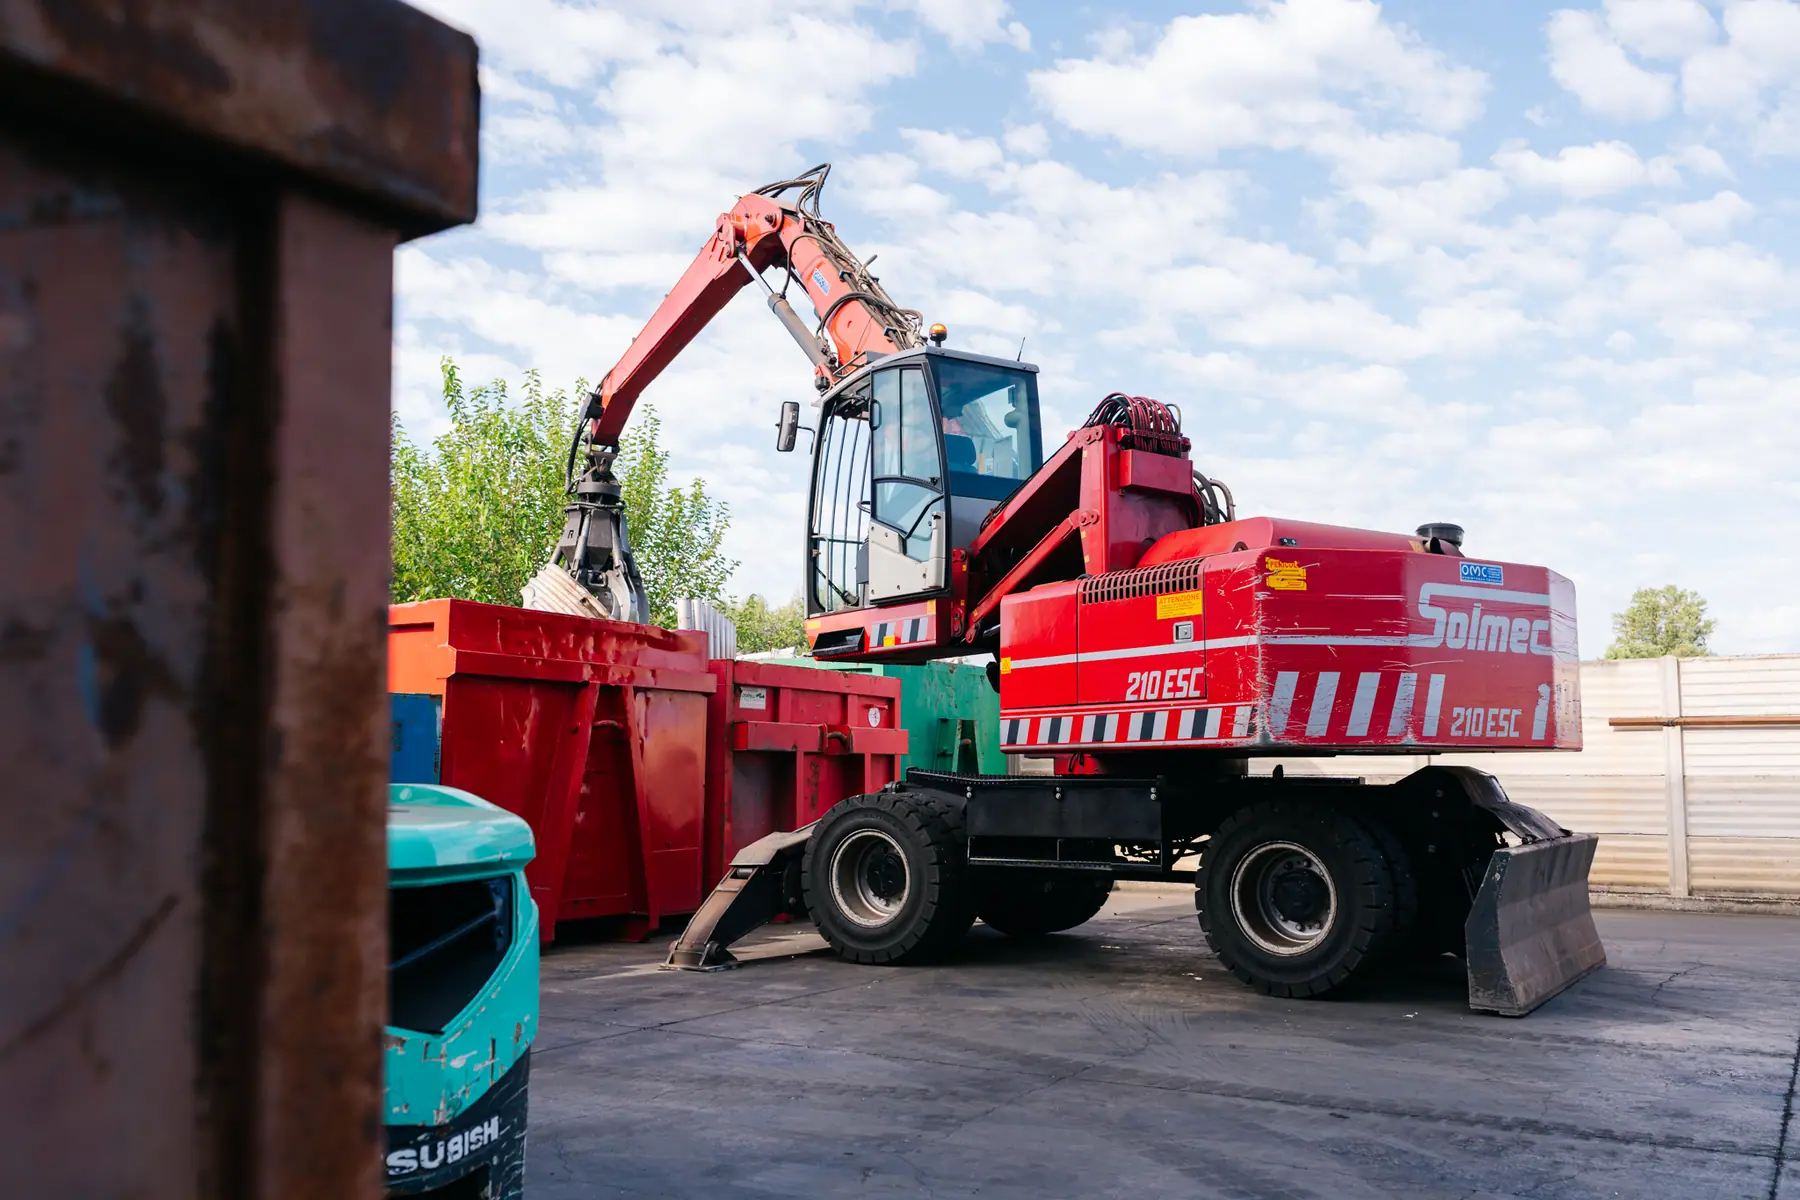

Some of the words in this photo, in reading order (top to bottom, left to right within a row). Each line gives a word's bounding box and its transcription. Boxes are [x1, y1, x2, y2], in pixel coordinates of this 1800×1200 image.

[1461, 564, 1488, 578] OMC
[1159, 593, 1200, 604] ATTENZIONE
[1418, 582, 1552, 656] Solmec
[1125, 671, 1161, 701] 210
[1162, 667, 1204, 699] ESC
[1450, 707, 1484, 736] 210
[1486, 708, 1522, 737] ESC
